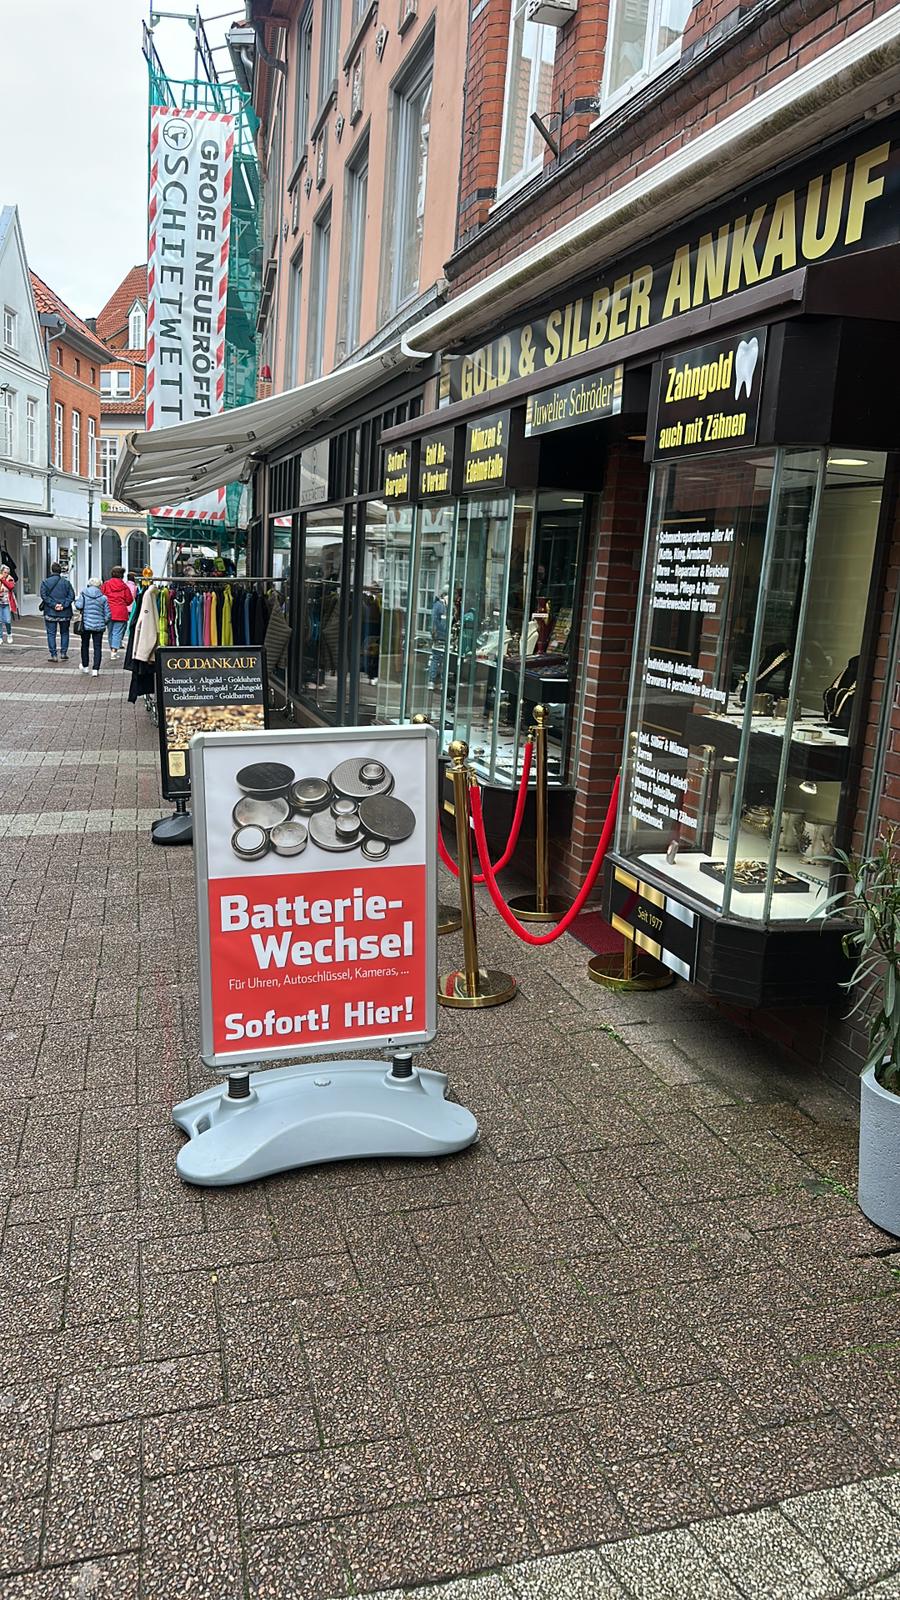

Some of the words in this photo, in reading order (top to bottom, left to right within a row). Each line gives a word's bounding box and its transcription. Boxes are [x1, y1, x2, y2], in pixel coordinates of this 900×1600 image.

[461, 344, 511, 400] GOLD
[518, 324, 536, 377] &
[544, 264, 654, 367] SILBER
[661, 141, 890, 319] ANKAUF
[192, 252, 214, 418] NEUERÖFF
[665, 351, 734, 403] Zahngold
[532, 393, 568, 427] Juwelier
[569, 378, 613, 416] Schröder
[471, 427, 496, 453] Münzen
[496, 420, 502, 446] &
[659, 421, 683, 449] auch
[684, 417, 703, 444] mit
[704, 412, 746, 441] Zähnen
[387, 449, 407, 472] Sofort
[426, 443, 437, 466] Gold
[427, 468, 448, 492] Verkauf
[466, 454, 503, 483] Edelmetalle
[386, 474, 408, 498] Bargeld
[660, 530, 710, 545] Schmuckreparaturen
[711, 529, 724, 542] aller
[724, 528, 734, 542] Art
[686, 547, 712, 562] Armband)
[656, 564, 670, 576] Uhren
[674, 564, 700, 579] Reparatur
[700, 564, 705, 577] &
[705, 564, 730, 578] Revision
[680, 581, 696, 596] Pflege
[696, 582, 700, 594] &
[701, 582, 720, 595] Politur
[653, 596, 691, 610] Batteriewechsel
[691, 598, 700, 612] für
[700, 598, 716, 612] Uhren
[167, 656, 257, 670] GOLDANKAUF
[648, 657, 674, 673] Individuelle
[674, 662, 704, 682] Anfertigung
[164, 686, 196, 694] Bruchgold
[202, 684, 228, 693] Feingold
[234, 684, 262, 692] Zahngold
[199, 676, 222, 685] Altgold
[646, 672, 666, 688] Gravuren
[667, 677, 672, 689] &
[671, 680, 700, 696] persönliche
[701, 684, 726, 704] Beratung
[638, 746, 652, 762] Barren
[650, 734, 664, 750] Silber
[664, 739, 668, 752] &
[668, 740, 688, 758] Münzen
[634, 776, 648, 791] Uhren
[648, 782, 652, 793] &
[652, 782, 676, 803] Tafelsilber
[636, 762, 656, 779] Schmuck
[656, 769, 670, 784] (auch
[670, 774, 688, 794] defekt)
[632, 805, 664, 830] Modeschmuck
[633, 790, 654, 809] Zahngold
[658, 804, 670, 816] auch
[670, 808, 678, 820] mit
[678, 810, 698, 828] Zähnen
[220, 888, 403, 932] Batterie-
[638, 906, 648, 922] Seit
[649, 914, 663, 931] 1977
[251, 920, 413, 970] Wechsel
[229, 978, 245, 990] Für
[248, 976, 281, 988] Uhren,
[284, 968, 352, 986] Autoschlüssel,
[355, 967, 399, 980] Kameras,
[225, 1004, 330, 1040] Sofort!
[344, 996, 414, 1028] Hier!
